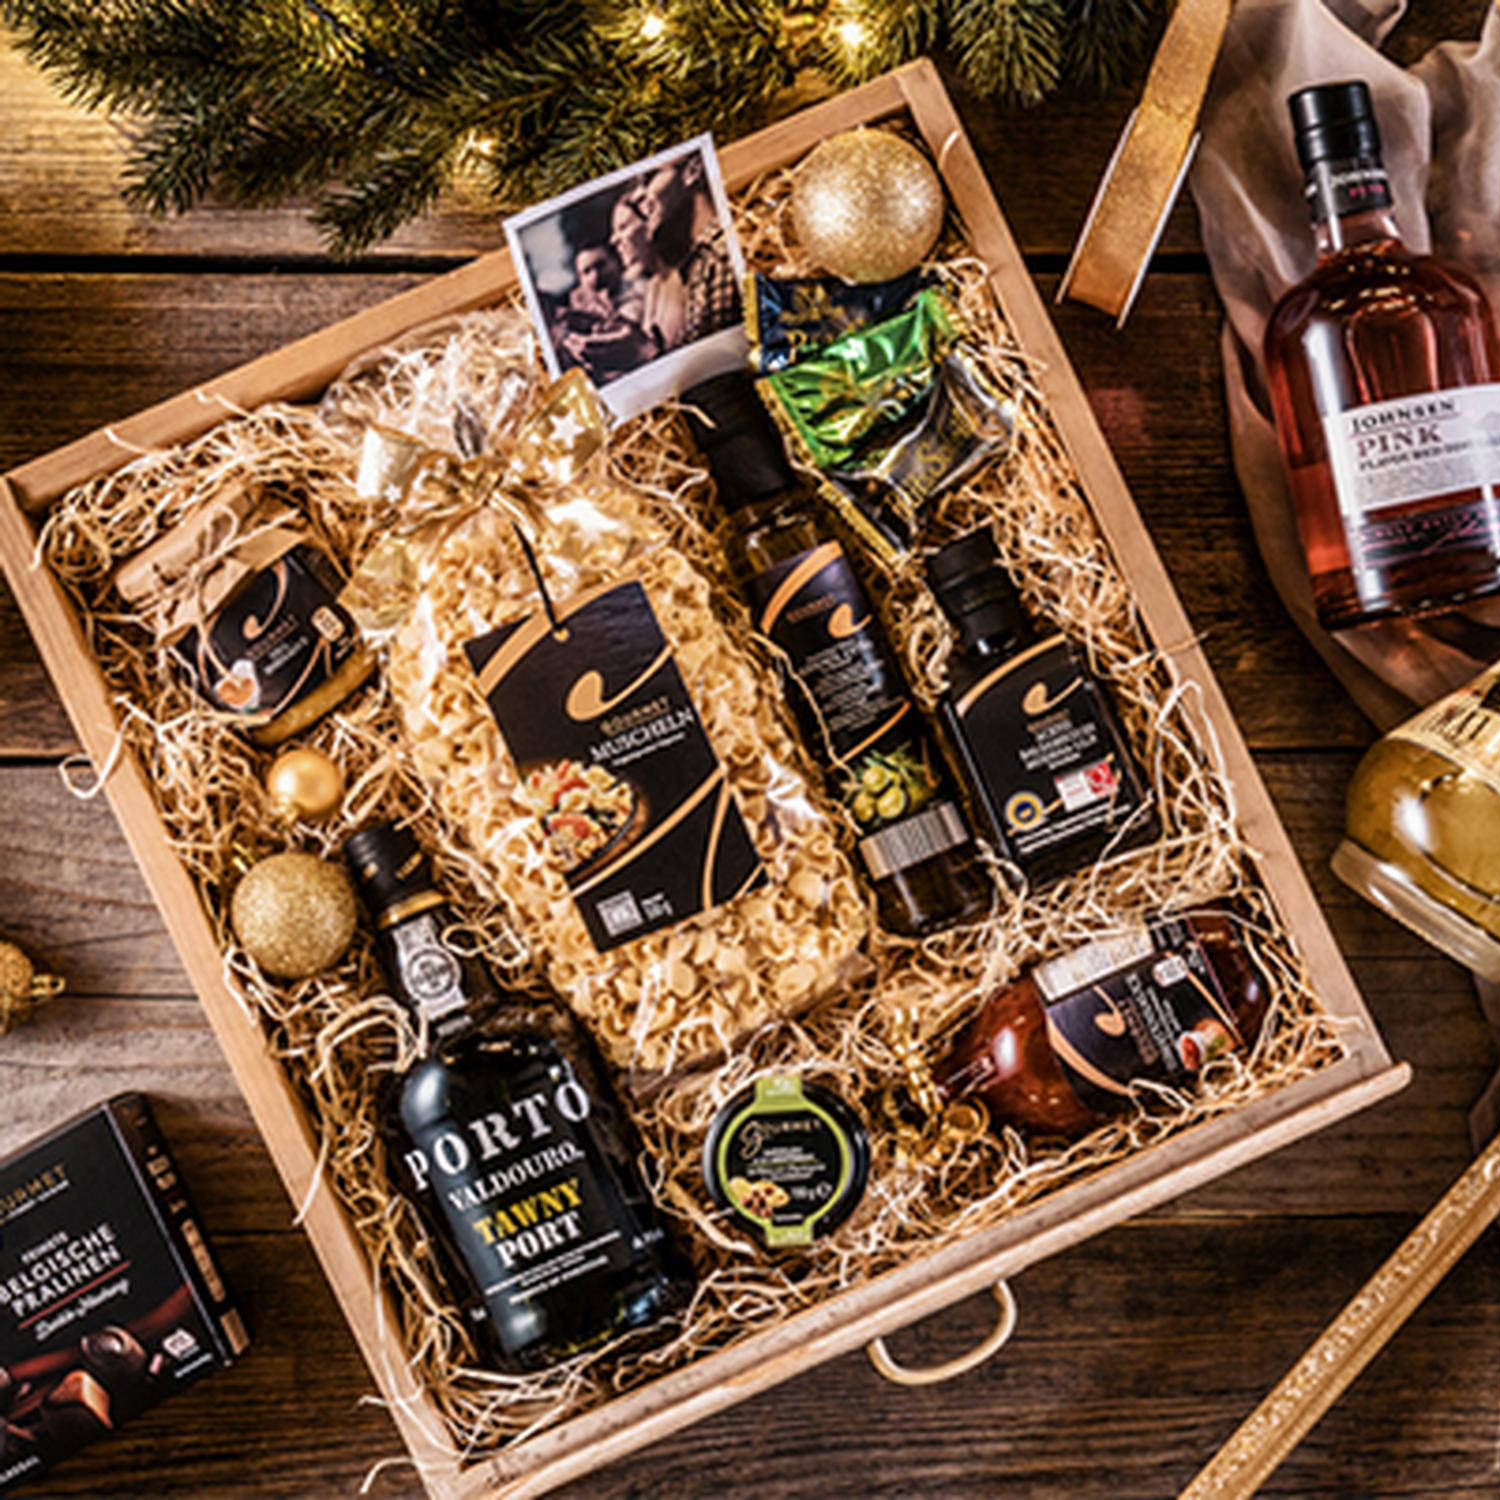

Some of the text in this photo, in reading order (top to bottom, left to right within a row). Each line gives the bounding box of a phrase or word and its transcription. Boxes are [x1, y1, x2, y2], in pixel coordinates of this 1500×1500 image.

[1351, 400, 1454, 434] JOHNSEN
[1357, 422, 1441, 458] PINK
[589, 706, 693, 763] MUSCHELN
[404, 1082, 590, 1190] PORTO
[471, 1177, 584, 1246] TAWNY
[495, 1210, 584, 1270] PORT
[12, 1244, 121, 1319] PRALINEN
